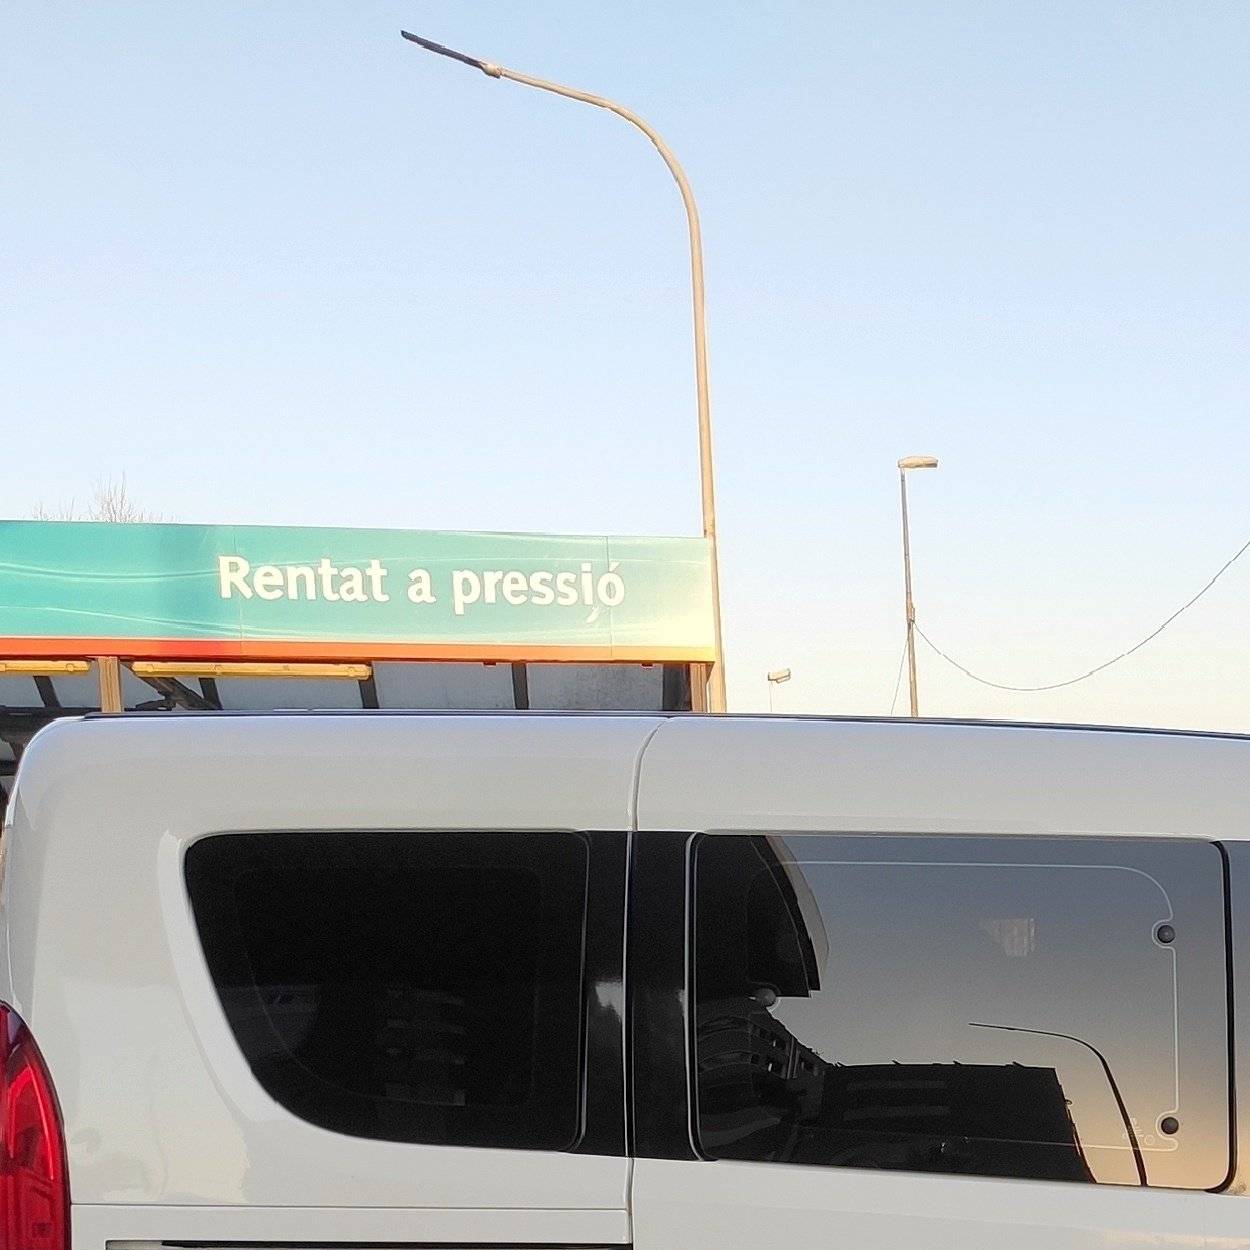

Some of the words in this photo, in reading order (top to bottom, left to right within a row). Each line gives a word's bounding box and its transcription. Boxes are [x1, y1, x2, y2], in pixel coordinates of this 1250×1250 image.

[217, 555, 390, 603] Rentat
[407, 567, 437, 604] a
[452, 562, 626, 616] pressió
